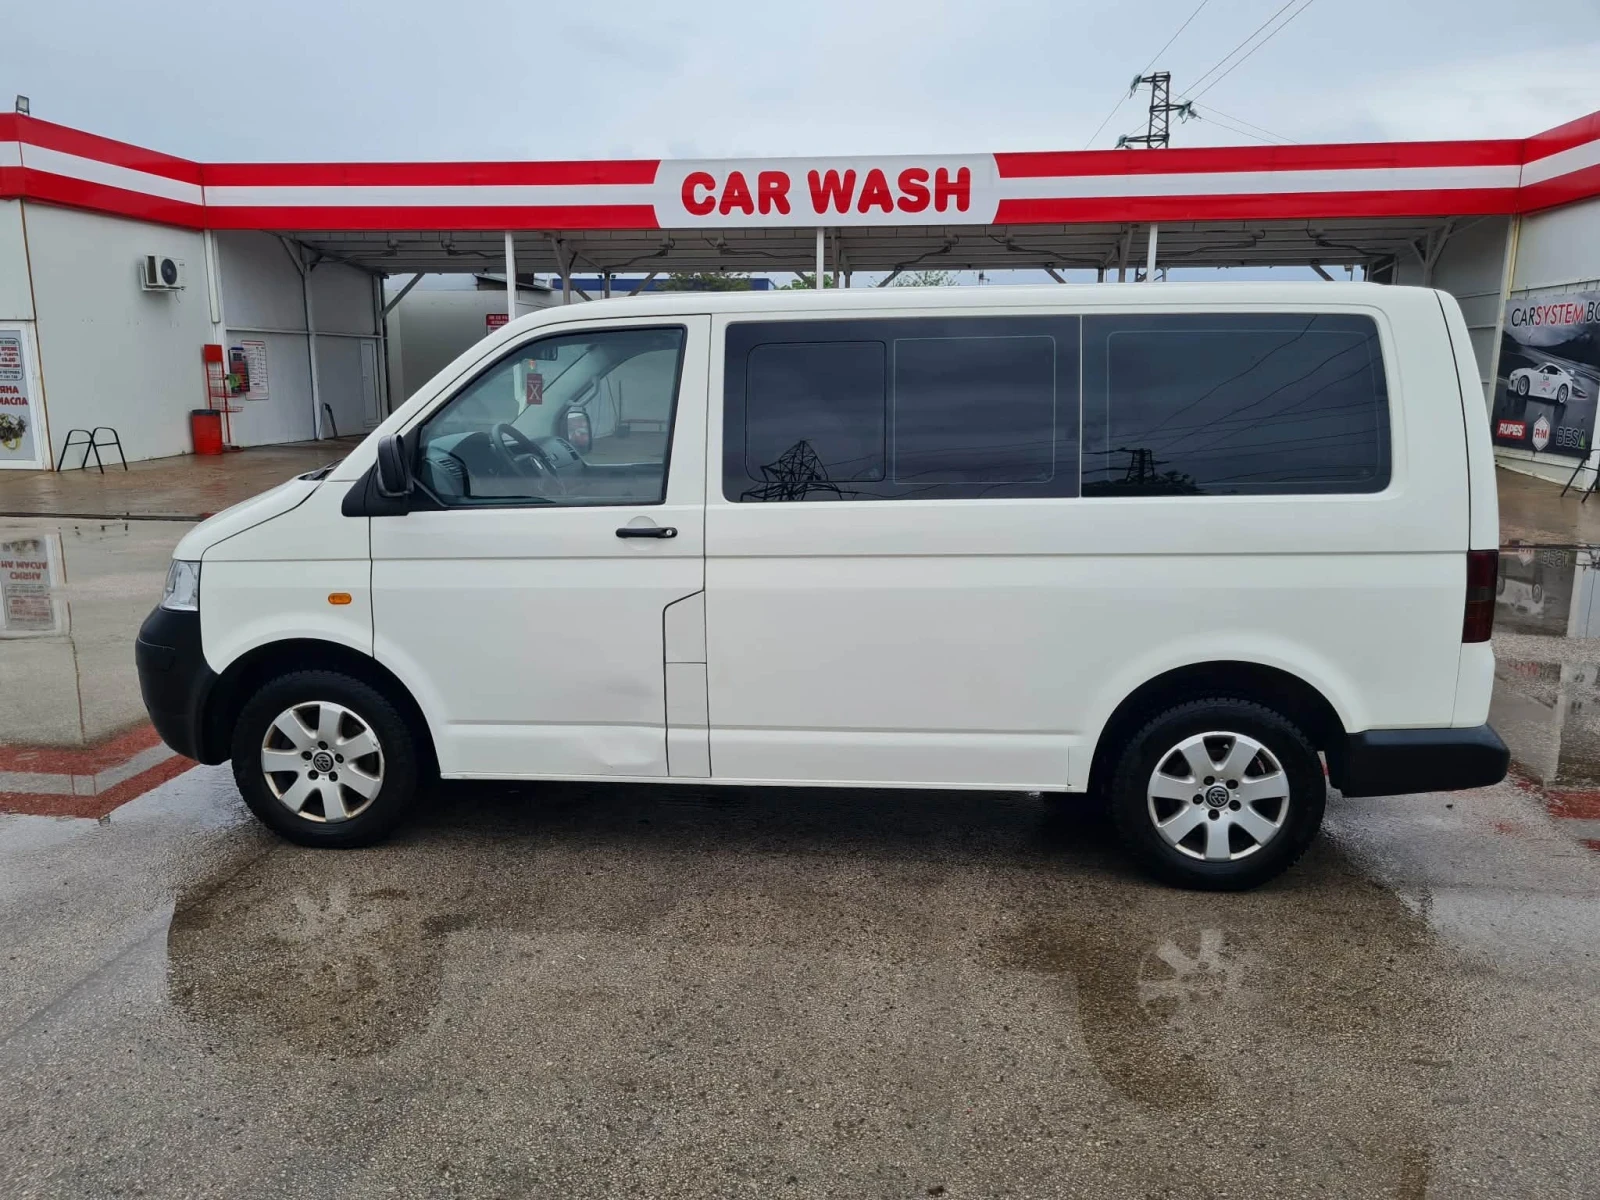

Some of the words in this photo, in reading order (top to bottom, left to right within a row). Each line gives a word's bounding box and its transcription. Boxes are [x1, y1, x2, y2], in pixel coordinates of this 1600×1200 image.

[681, 170, 791, 216] CAR
[807, 166, 971, 214] WASH
[1511, 303, 1584, 327] CARSYSTEM
[1498, 422, 1525, 437] RUPES
